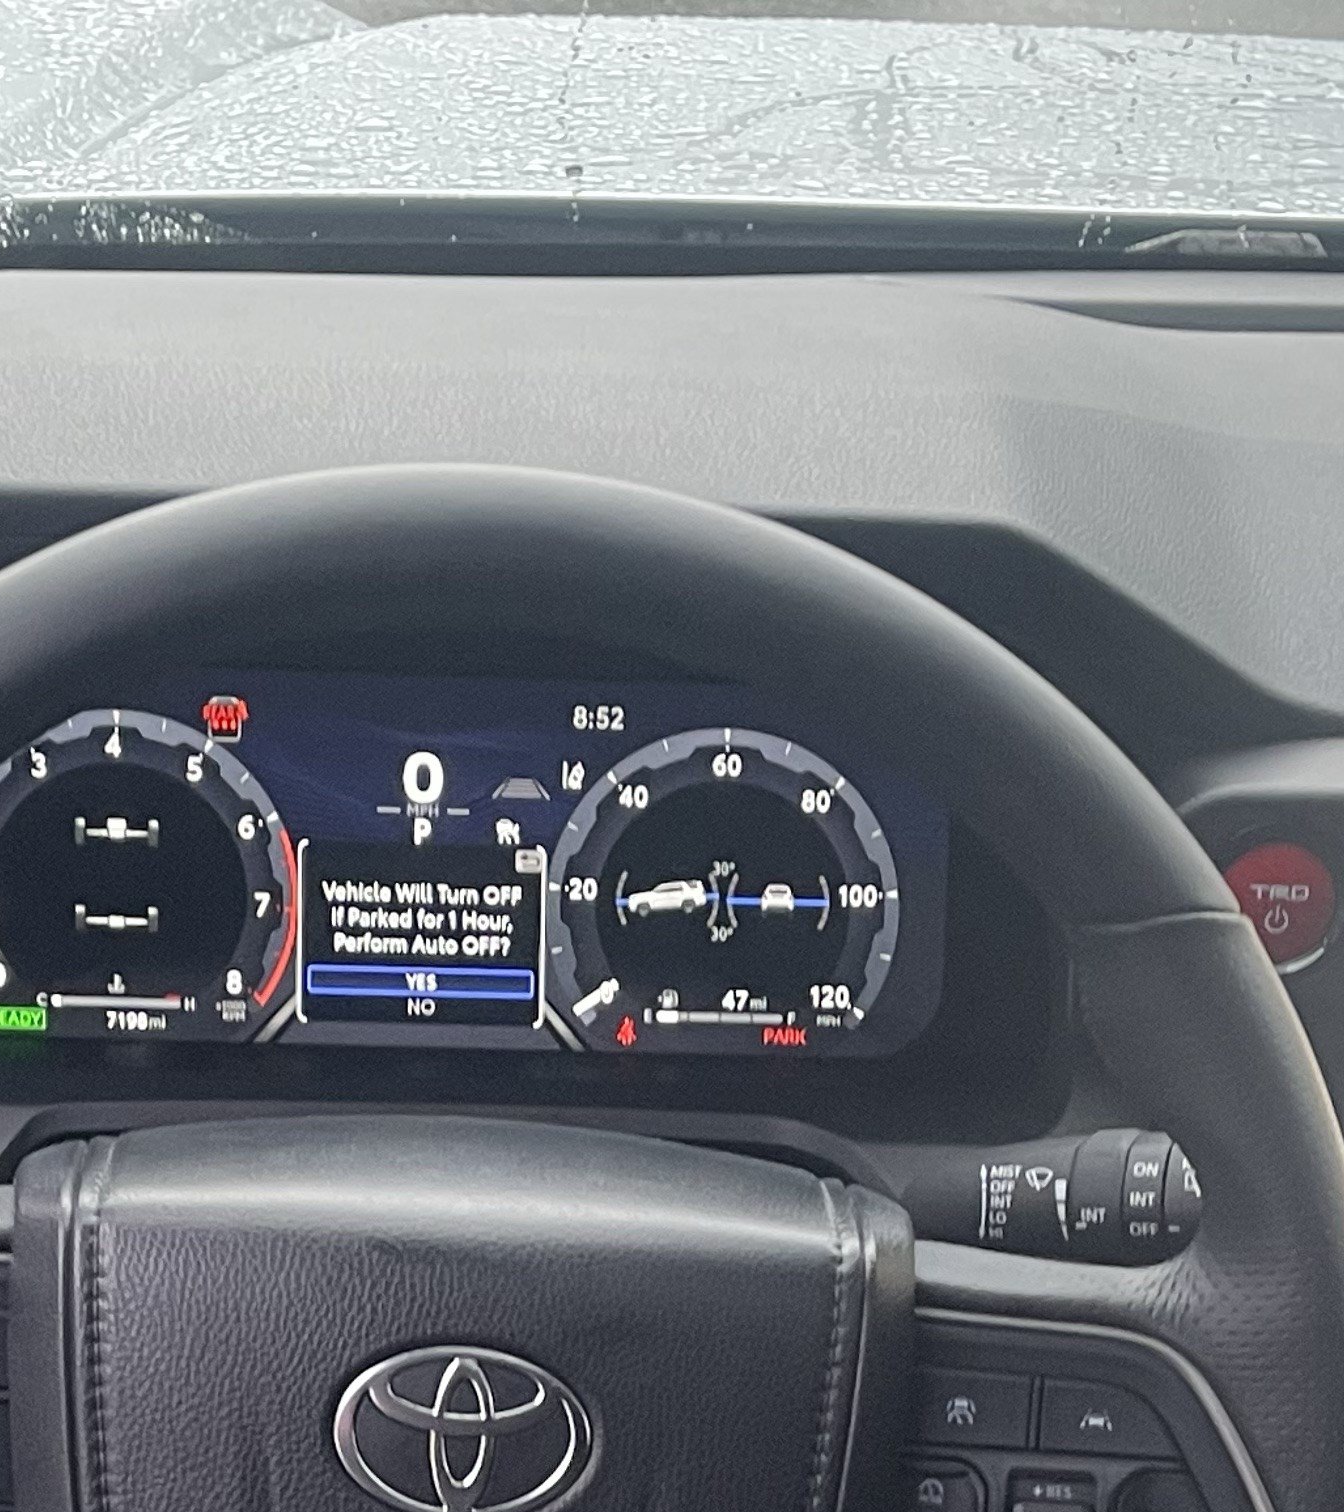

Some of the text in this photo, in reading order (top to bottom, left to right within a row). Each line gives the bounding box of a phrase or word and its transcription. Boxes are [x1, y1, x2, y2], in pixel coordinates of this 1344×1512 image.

[573, 705, 625, 731] 8:52
[104, 733, 122, 757] 4
[30, 752, 47, 778] 3
[186, 755, 202, 782] 5
[712, 754, 742, 777] 60
[403, 751, 444, 803] 0
[620, 785, 648, 808] 40
[801, 790, 831, 813] 80
[407, 803, 439, 817] MPH
[237, 815, 255, 839] 6
[413, 818, 432, 845] P
[322, 881, 522, 906] Vehicle Will Turn OFF
[570, 878, 598, 900] 20
[838, 885, 877, 908] 100
[1249, 883, 1310, 900] TRD
[255, 892, 270, 918] 7
[331, 906, 346, 927] If
[348, 907, 412, 928] Parked
[417, 909, 444, 929] for
[447, 911, 456, 930] 1
[333, 932, 511, 956] Perform Auto OFF?
[226, 969, 243, 995] 8
[405, 973, 438, 991] YES
[407, 999, 436, 1016] NO
[721, 990, 749, 1011] 47
[810, 987, 850, 1009] 120
[763, 1028, 806, 1045] PARK
[1133, 1162, 1160, 1178] ON
[1129, 1191, 1156, 1208] INT
[1129, 1222, 1157, 1238] OFF
